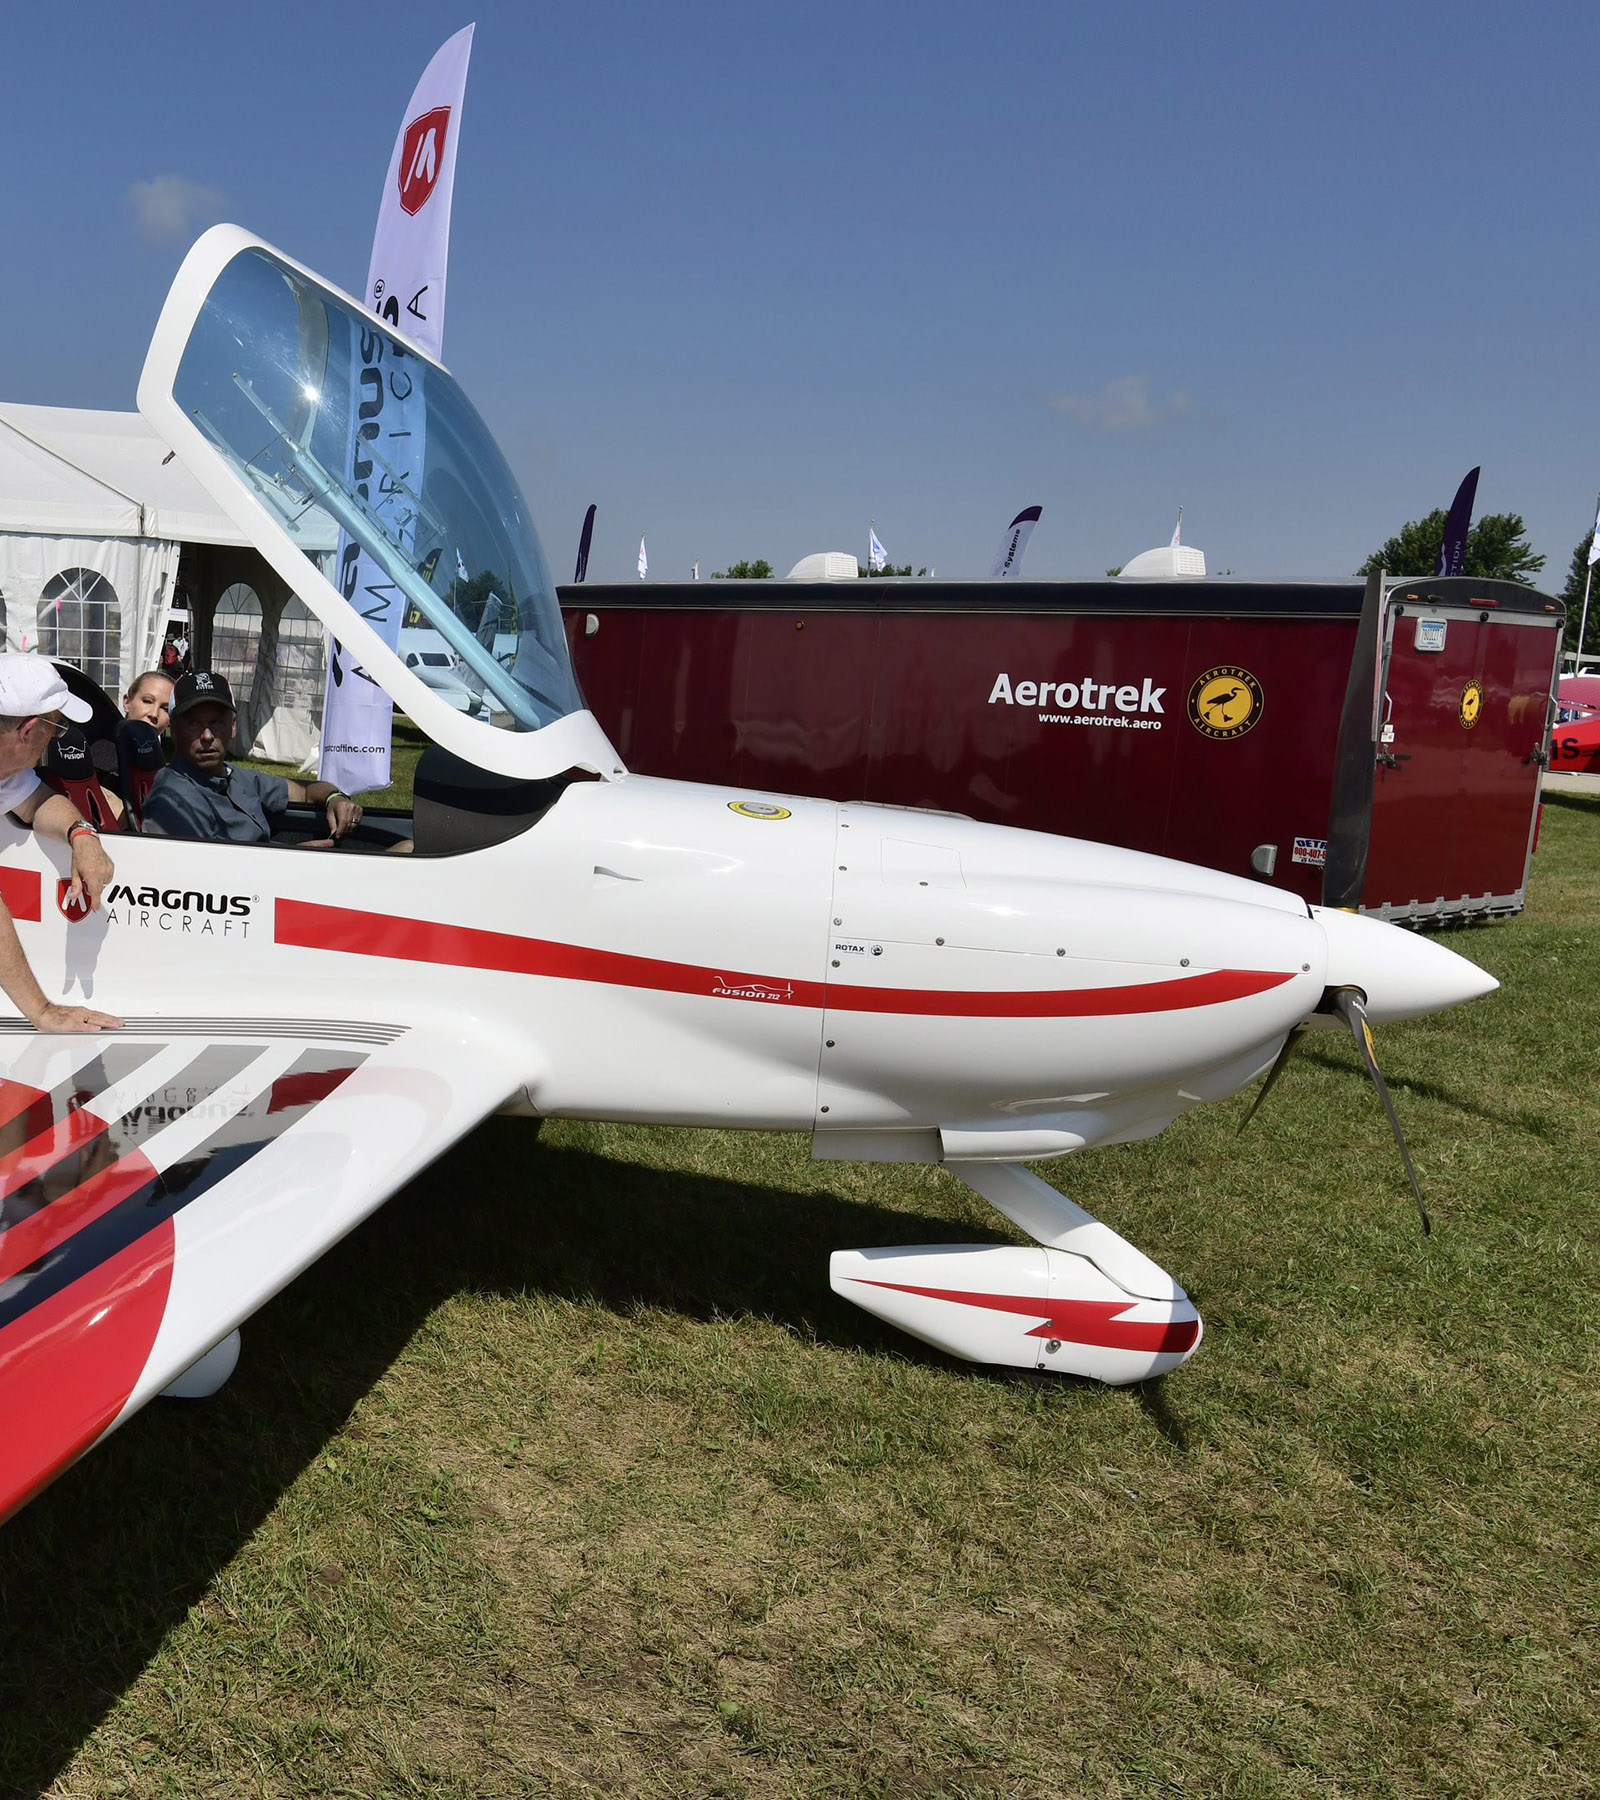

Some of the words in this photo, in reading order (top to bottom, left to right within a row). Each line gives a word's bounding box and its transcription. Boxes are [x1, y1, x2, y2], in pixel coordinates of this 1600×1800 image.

[1004, 529, 1020, 569] Systems
[1199, 667, 1257, 690] AEROTREK
[988, 672, 1167, 714] Aerotrek
[1038, 711, 1162, 731] www.aerotrek.aero
[1193, 716, 1253, 738] AIRCRAFT
[106, 908, 250, 939] AIRCRAFT
[835, 943, 865, 953] ROTAX
[712, 987, 766, 999] FUSION
[767, 993, 781, 1001] 212
